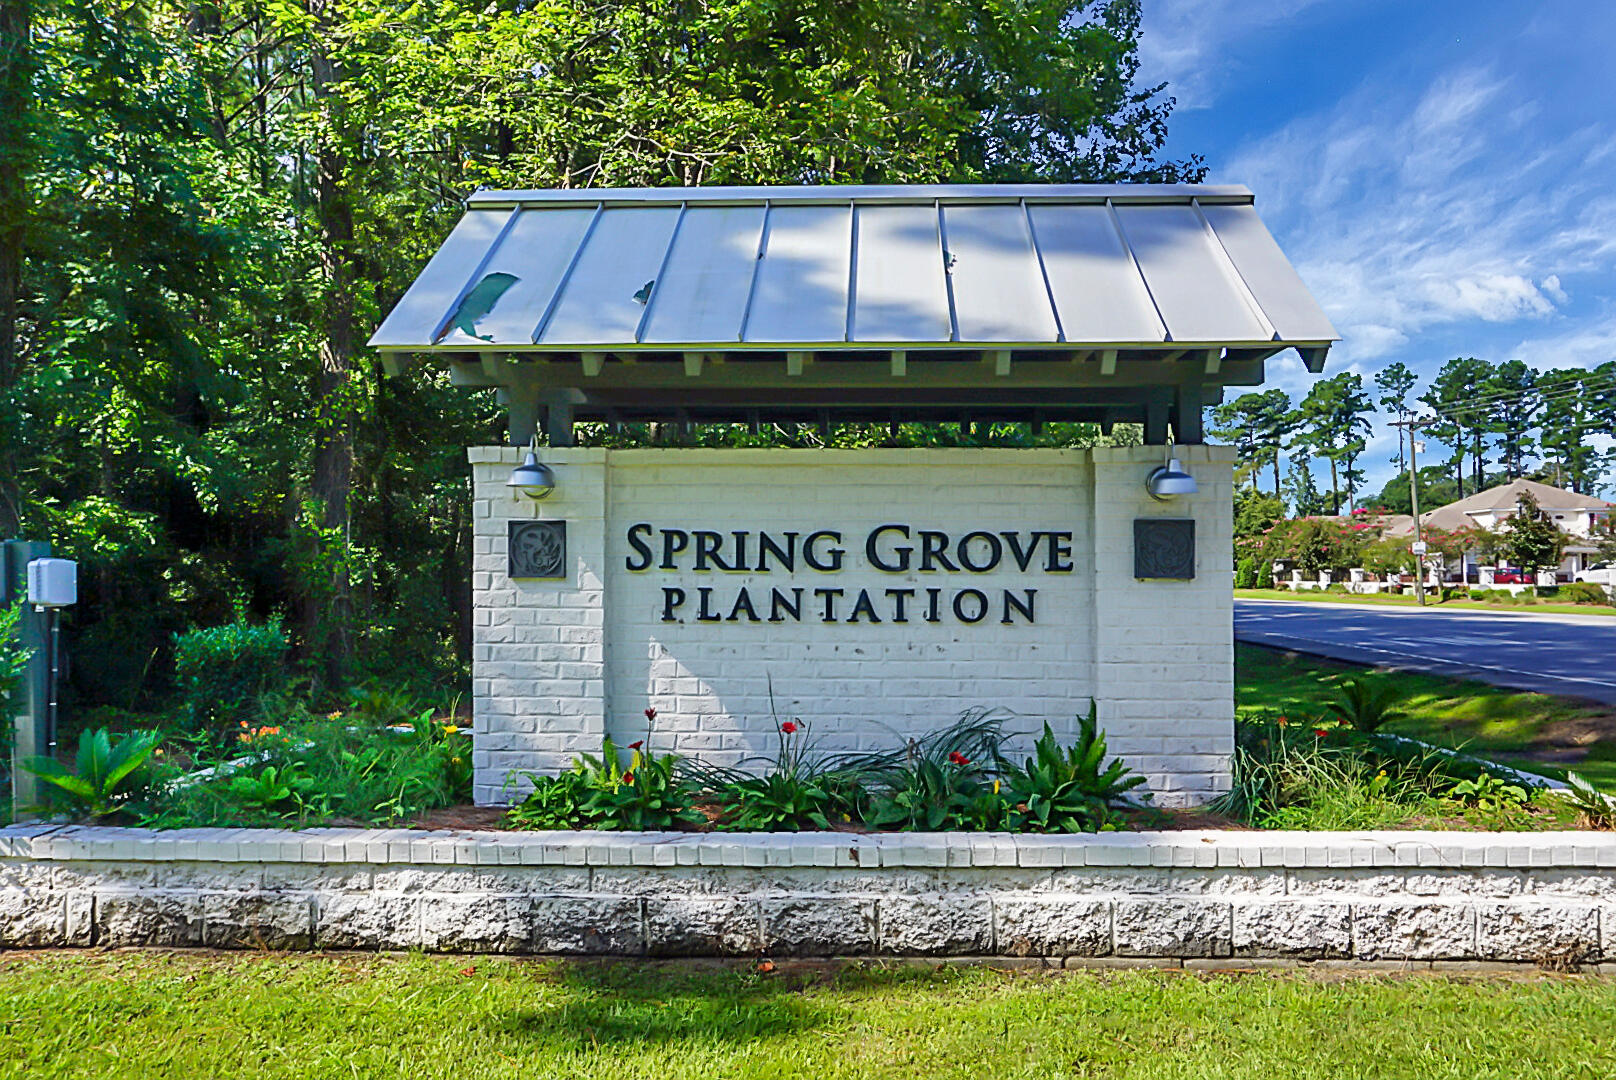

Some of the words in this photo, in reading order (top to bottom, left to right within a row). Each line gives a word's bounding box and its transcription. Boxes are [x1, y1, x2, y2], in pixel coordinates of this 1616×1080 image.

[625, 523, 846, 573] SPRING
[865, 524, 1074, 573] GROVE
[660, 587, 1038, 624] PLANTATION
